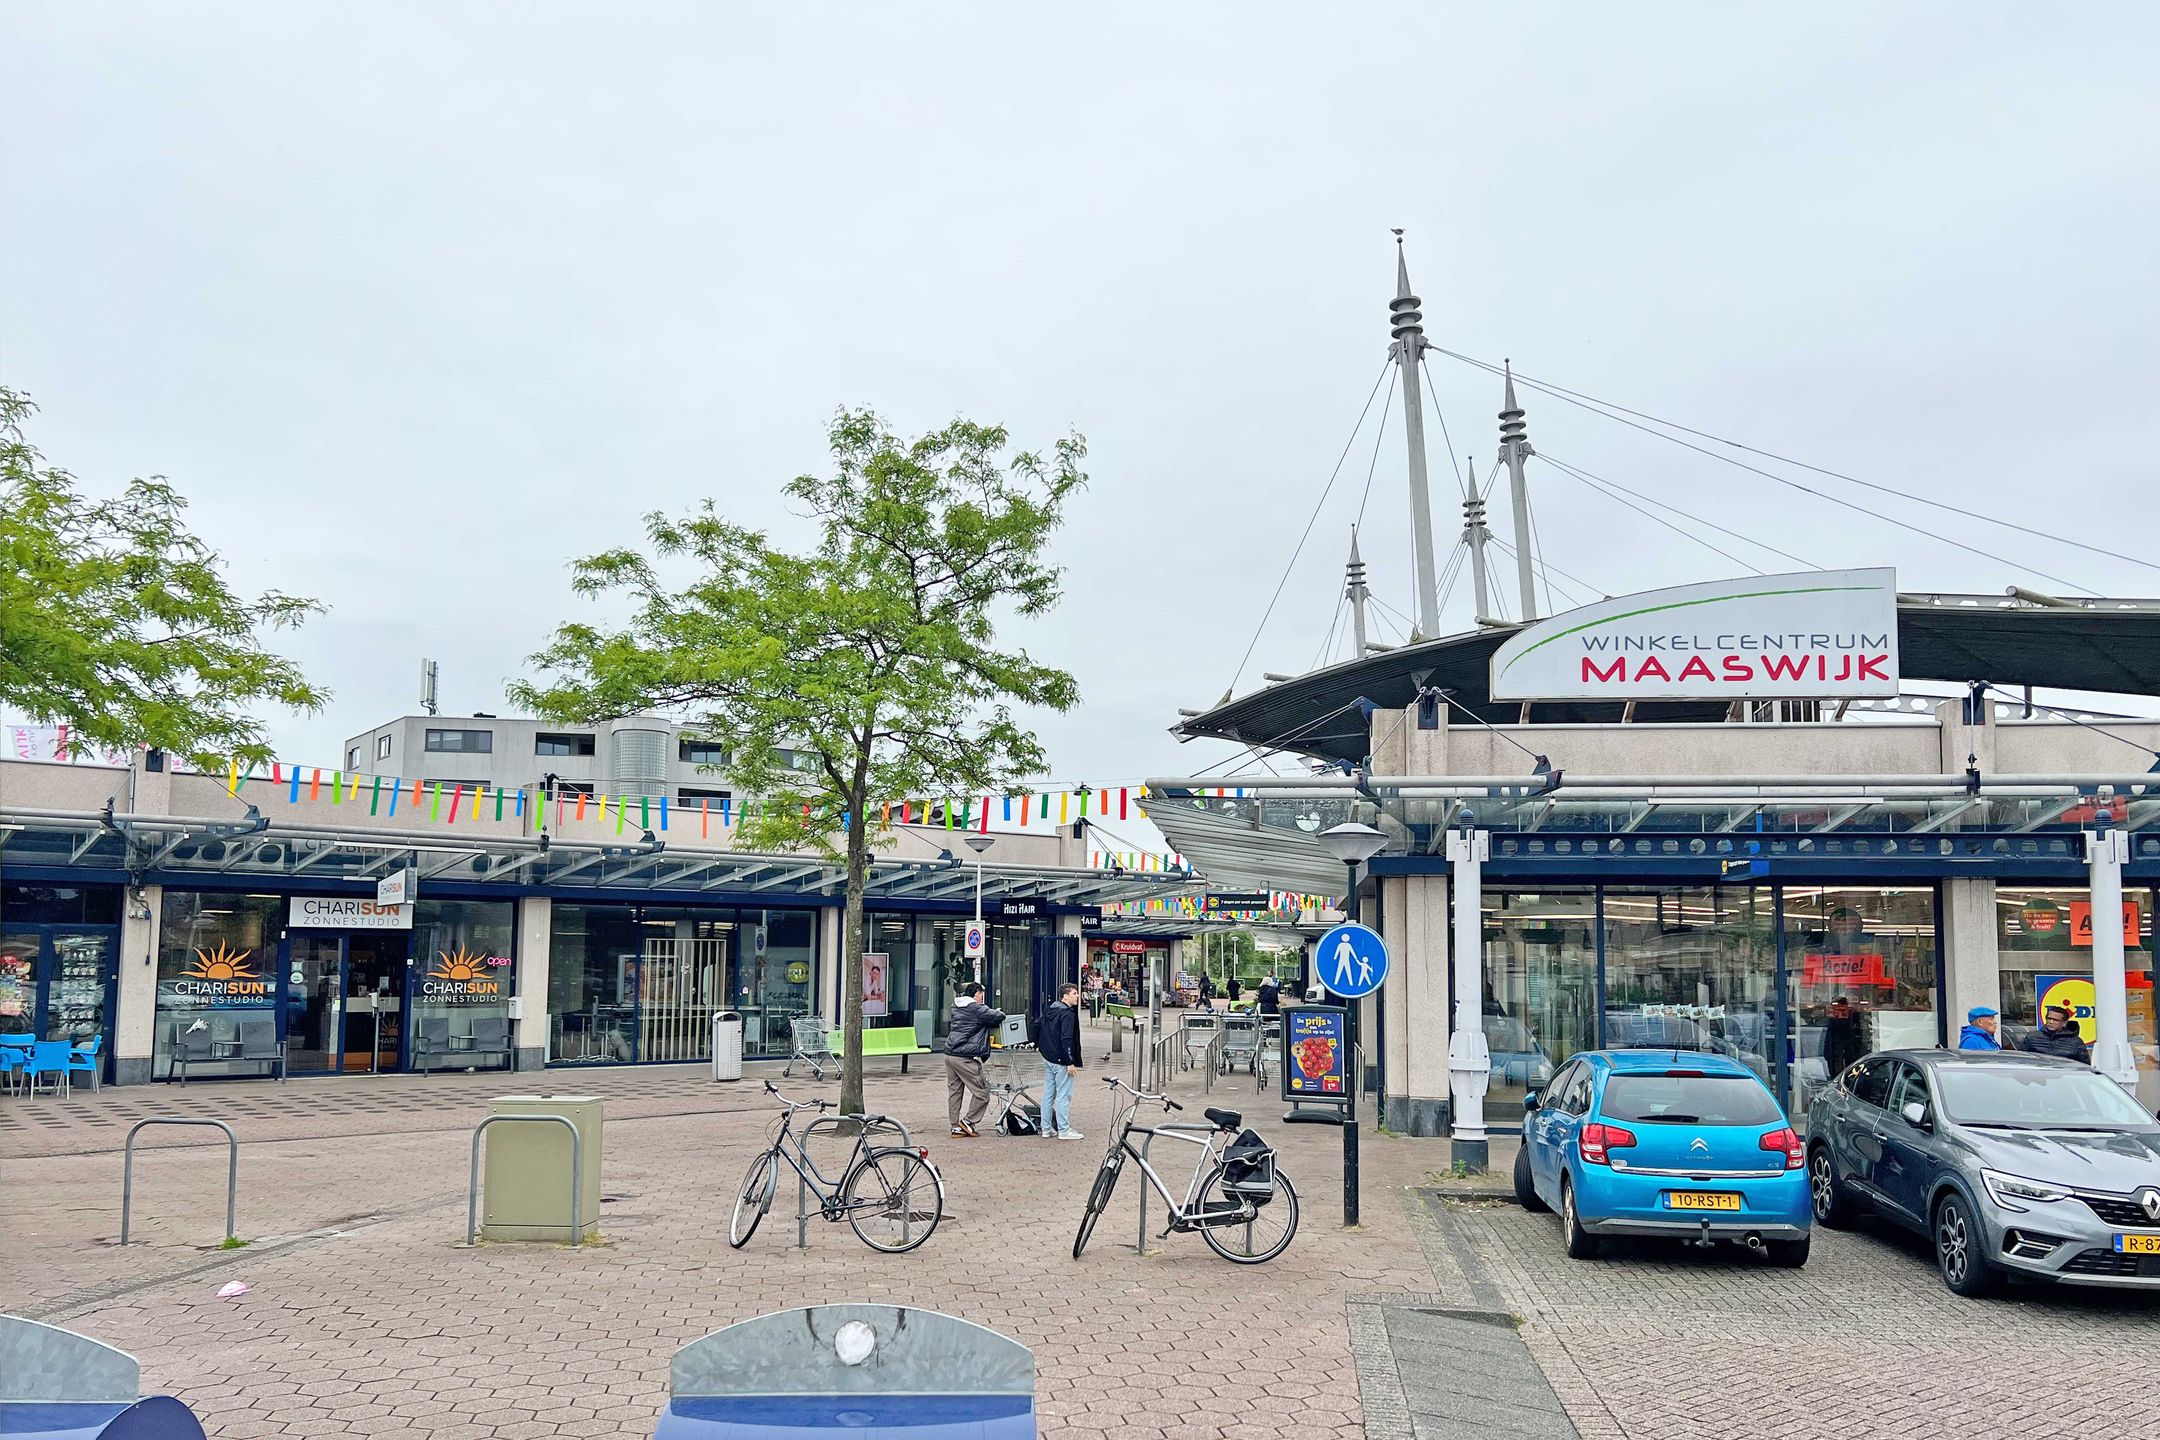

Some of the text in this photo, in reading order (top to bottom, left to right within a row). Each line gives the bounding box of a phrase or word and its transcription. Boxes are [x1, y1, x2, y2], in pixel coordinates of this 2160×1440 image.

[1581, 633, 1888, 651] WINKELCENTRUM
[1581, 654, 1890, 683] MAASWIJK
[303, 900, 401, 916] CHARISUN
[1018, 903, 1036, 914] HAIR
[303, 916, 401, 927] ZONNESTUDIO
[1120, 943, 1143, 951] Kruidvat
[487, 957, 512, 967] open
[1824, 958, 1865, 974] Actie!
[174, 981, 265, 995] CHARISUN
[422, 981, 498, 994] CHARISUN
[174, 995, 264, 1005] ZONNESTUDIO
[422, 995, 498, 1003] ZONNESTUDIO
[1306, 1017, 1326, 1027] prijs
[1678, 1194, 1732, 1208] 10-RST-1
